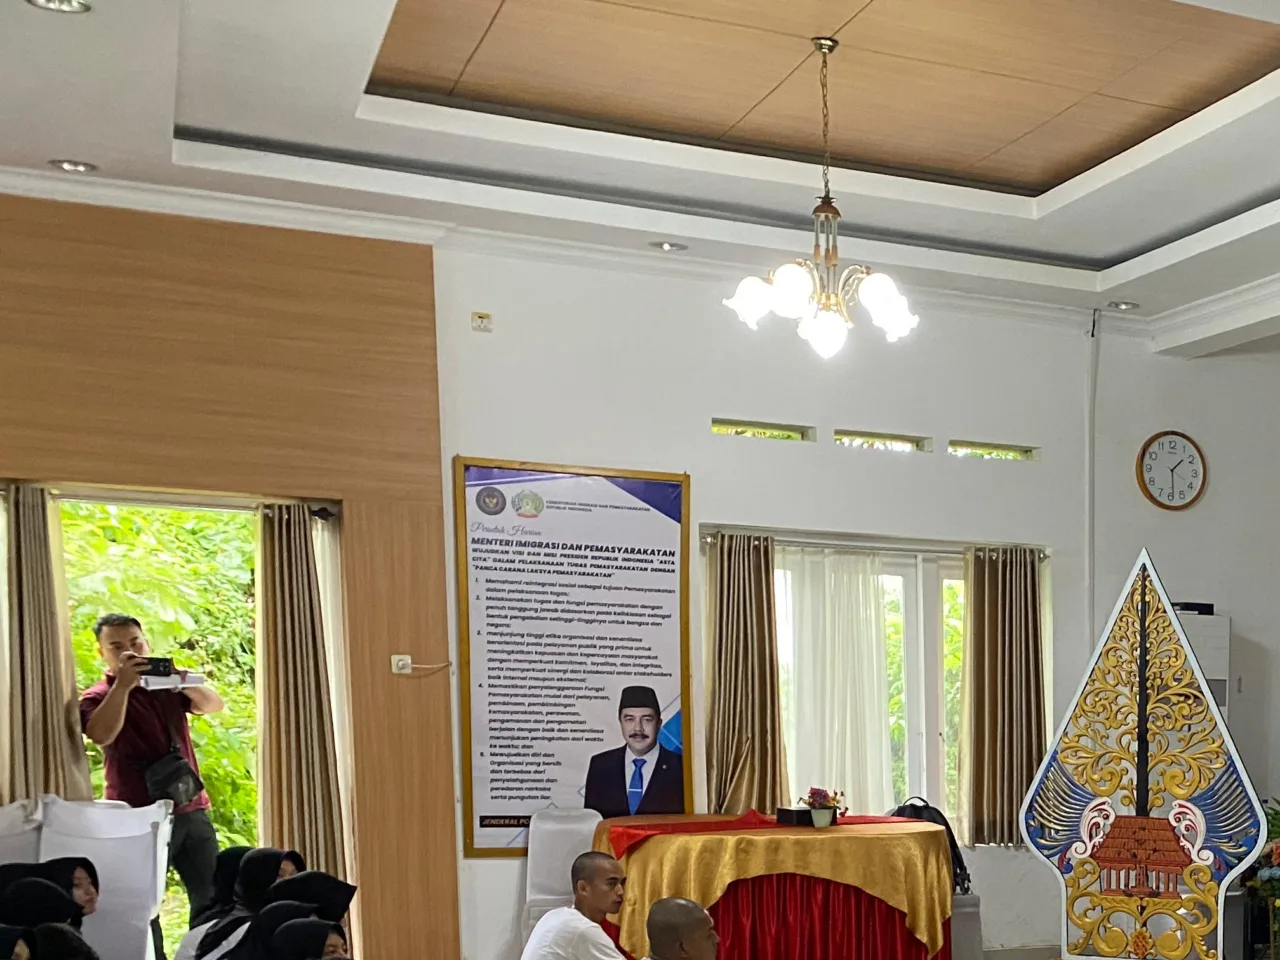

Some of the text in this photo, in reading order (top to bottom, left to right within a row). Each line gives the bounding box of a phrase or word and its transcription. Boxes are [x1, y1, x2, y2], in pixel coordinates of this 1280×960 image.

[1158, 442, 1164, 451] 11
[1169, 440, 1177, 449] 12
[1182, 446, 1186, 454] 1
[1148, 452, 1157, 460] 10
[1188, 455, 1194, 464] 2
[1146, 464, 1152, 472] 9
[1191, 469, 1198, 478] 3
[1148, 477, 1155, 486] 8
[1188, 482, 1193, 490] 4
[1158, 488, 1164, 497] 7
[1168, 492, 1174, 501] 6
[1179, 491, 1185, 500] 5
[470, 537, 675, 558] MENTERI IMIGRASI DAN PEMASYARAKATAN
[517, 559, 564, 567] PELAKSANAAN
[589, 563, 648, 572] PEMASYARAKATAN
